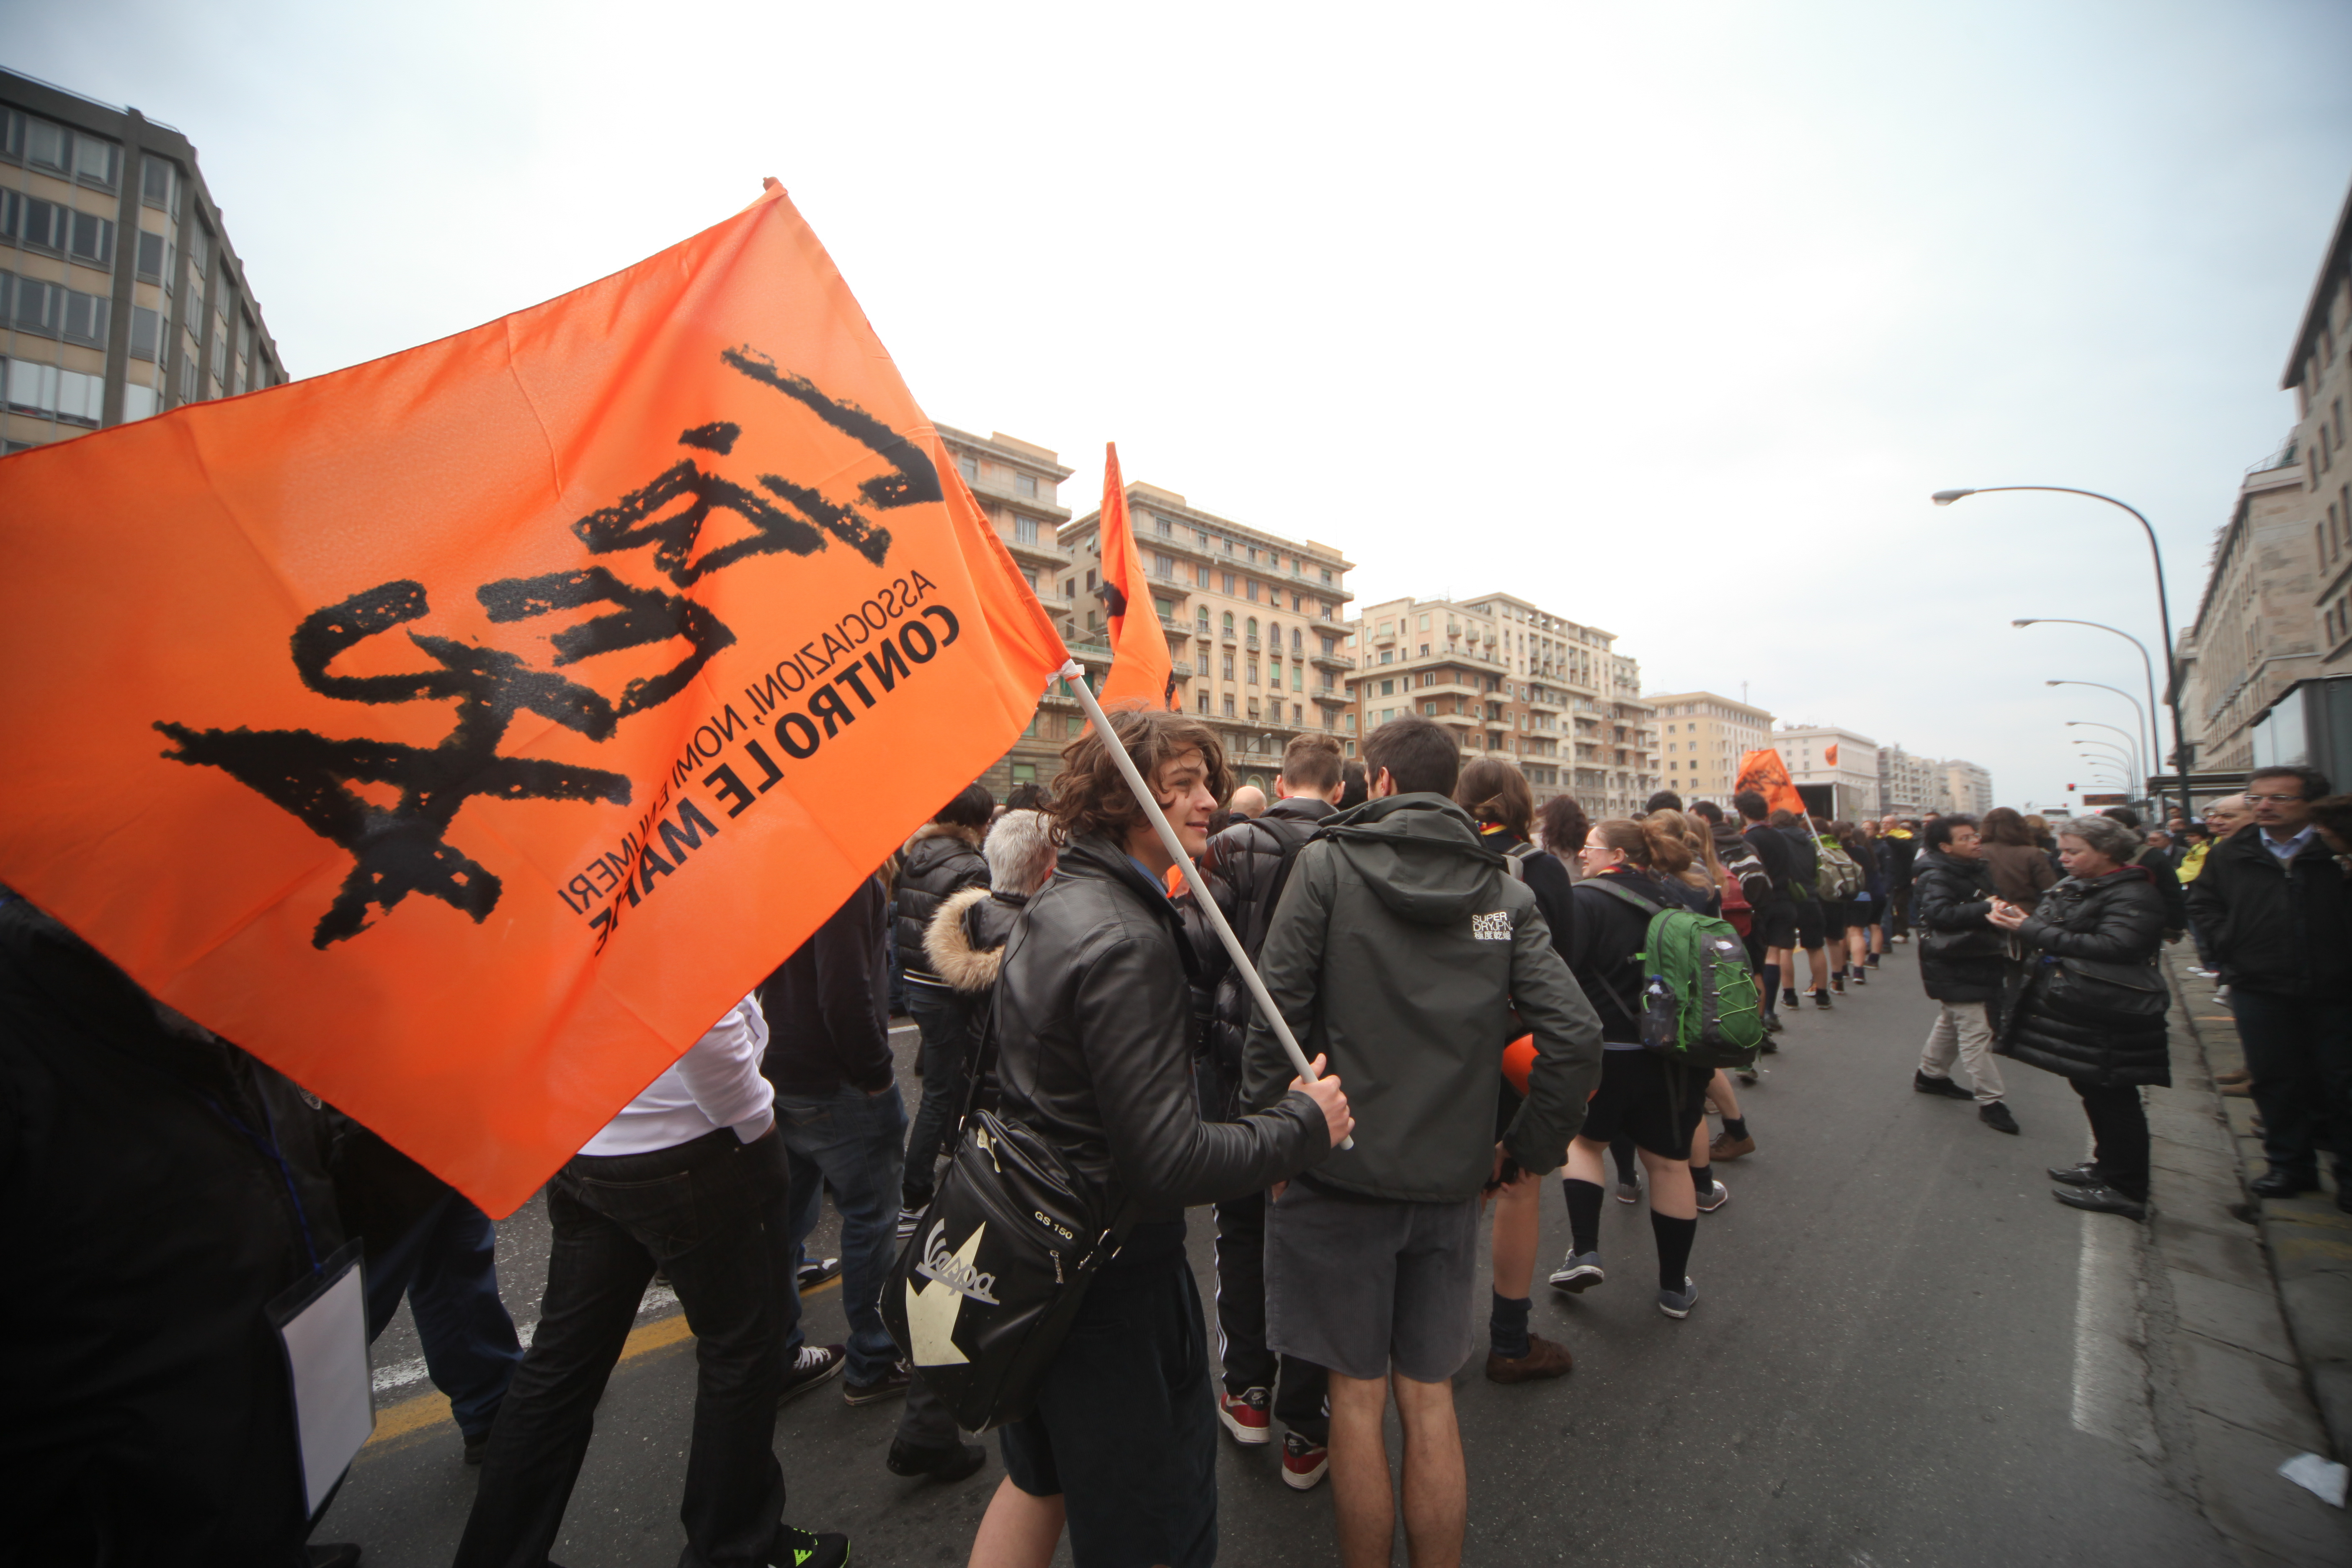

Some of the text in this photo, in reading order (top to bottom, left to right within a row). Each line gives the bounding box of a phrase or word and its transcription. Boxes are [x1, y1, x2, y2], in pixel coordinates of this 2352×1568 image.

[1472, 912, 1508, 923] SUPER
[1474, 931, 1511, 941] 極度乾燥
[1035, 1211, 1073, 1240] GS 150
[916, 1218, 1000, 1305] Vespa
